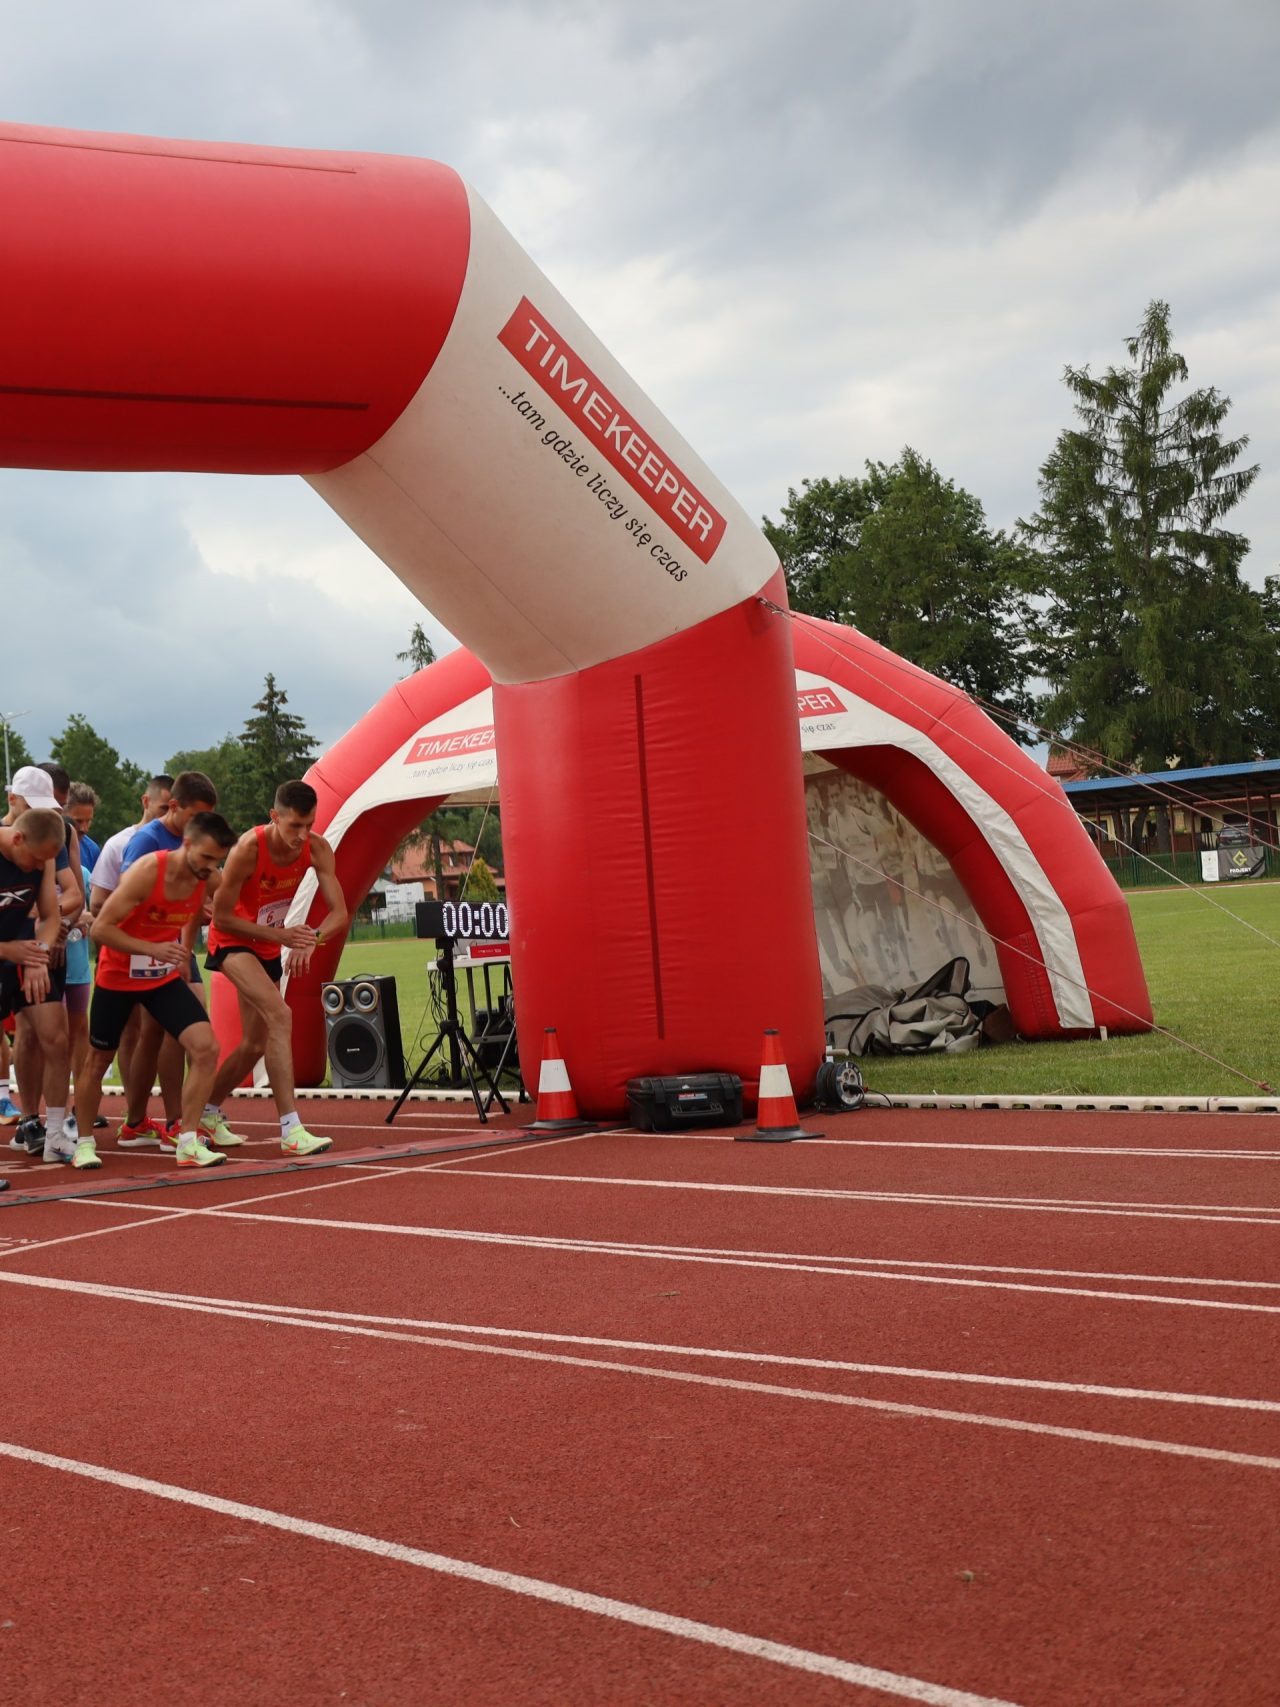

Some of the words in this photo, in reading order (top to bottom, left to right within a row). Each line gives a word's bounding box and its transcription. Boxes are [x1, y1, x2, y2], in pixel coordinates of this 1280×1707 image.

[498, 386, 546, 431] ...tam
[541, 430, 589, 477] gdzie
[586, 473, 629, 520] liczy
[625, 517, 652, 547] się
[651, 544, 688, 582] czas
[524, 319, 714, 543] TIMEKEEPER
